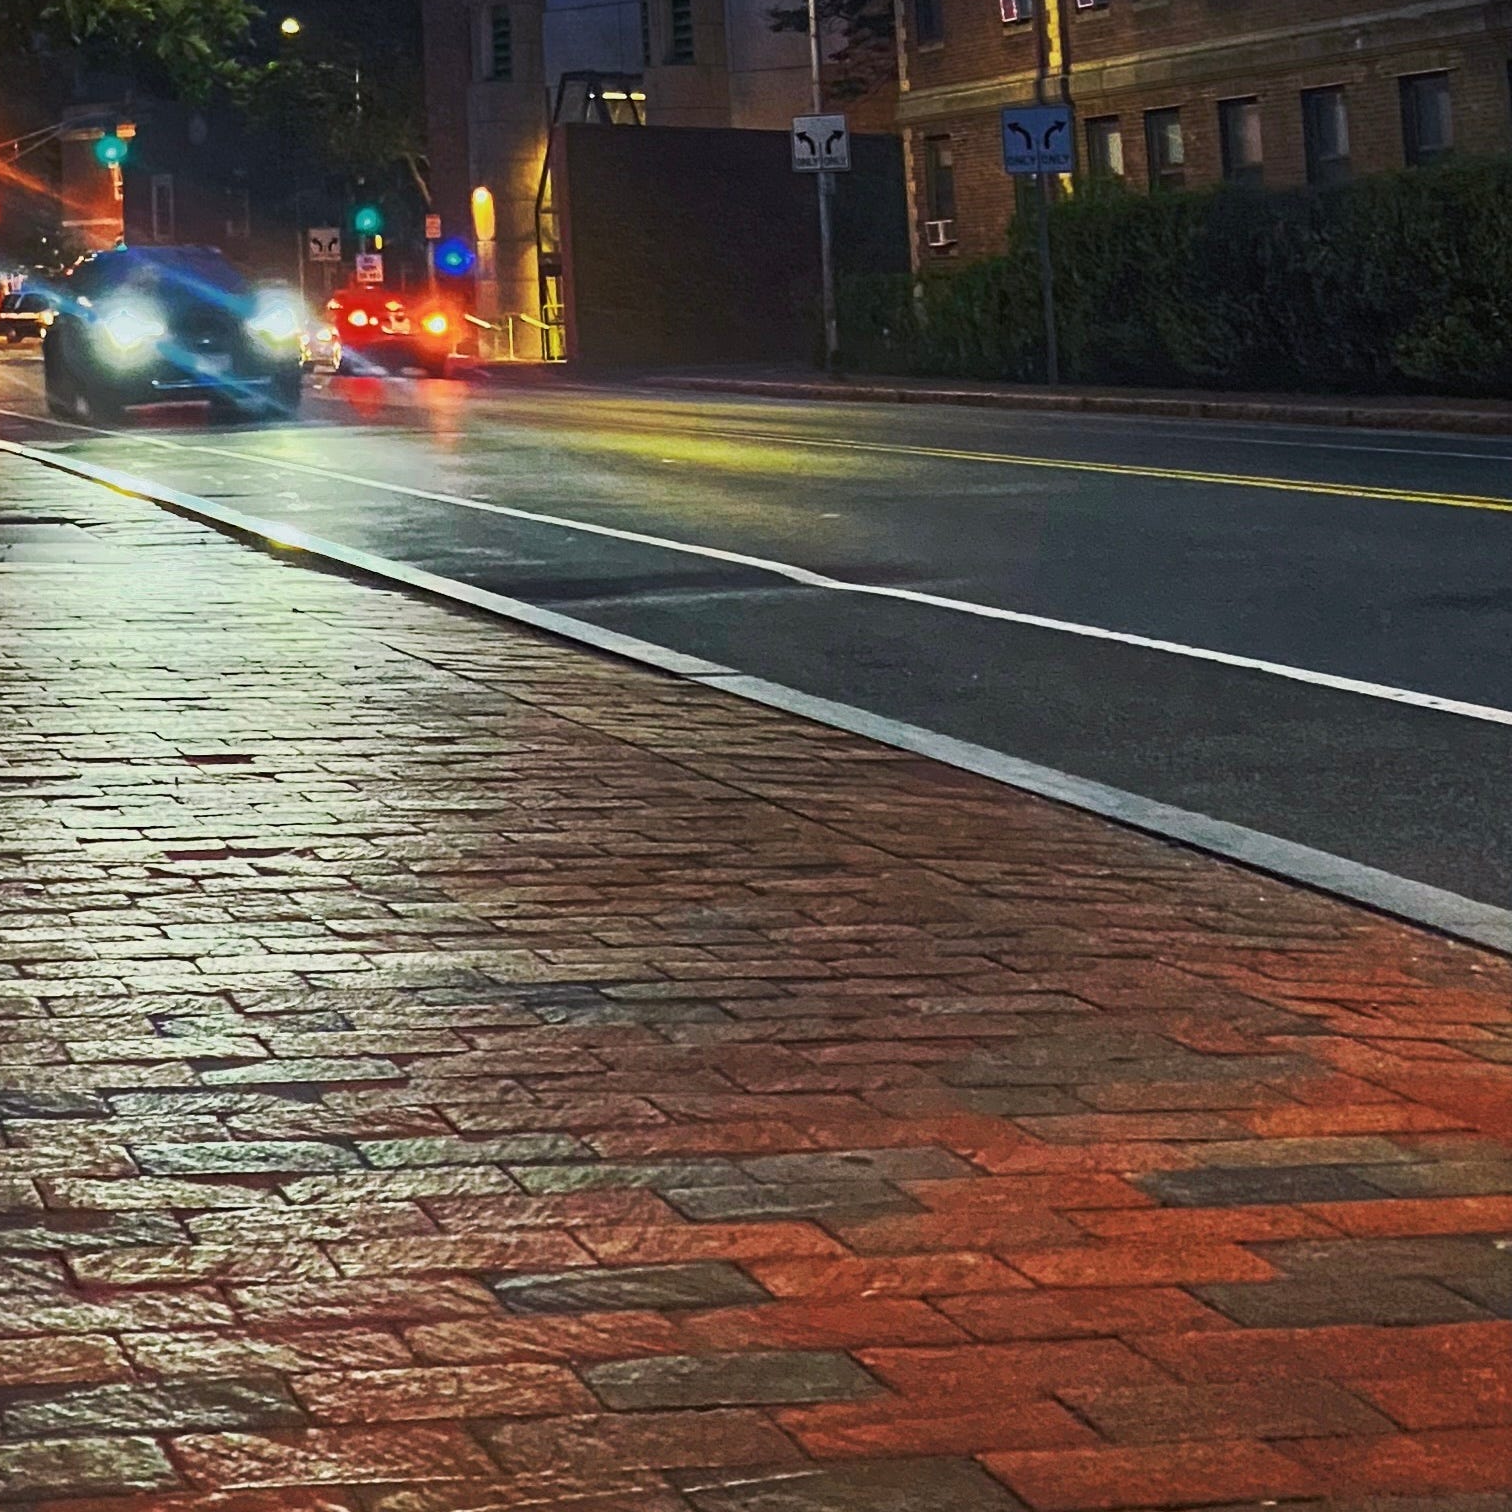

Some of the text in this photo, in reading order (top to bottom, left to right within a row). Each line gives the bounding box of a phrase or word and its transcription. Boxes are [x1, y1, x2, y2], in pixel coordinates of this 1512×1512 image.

[796, 156, 846, 167] ONLY ONLY
[1006, 154, 1070, 166] ONLY ONLY
